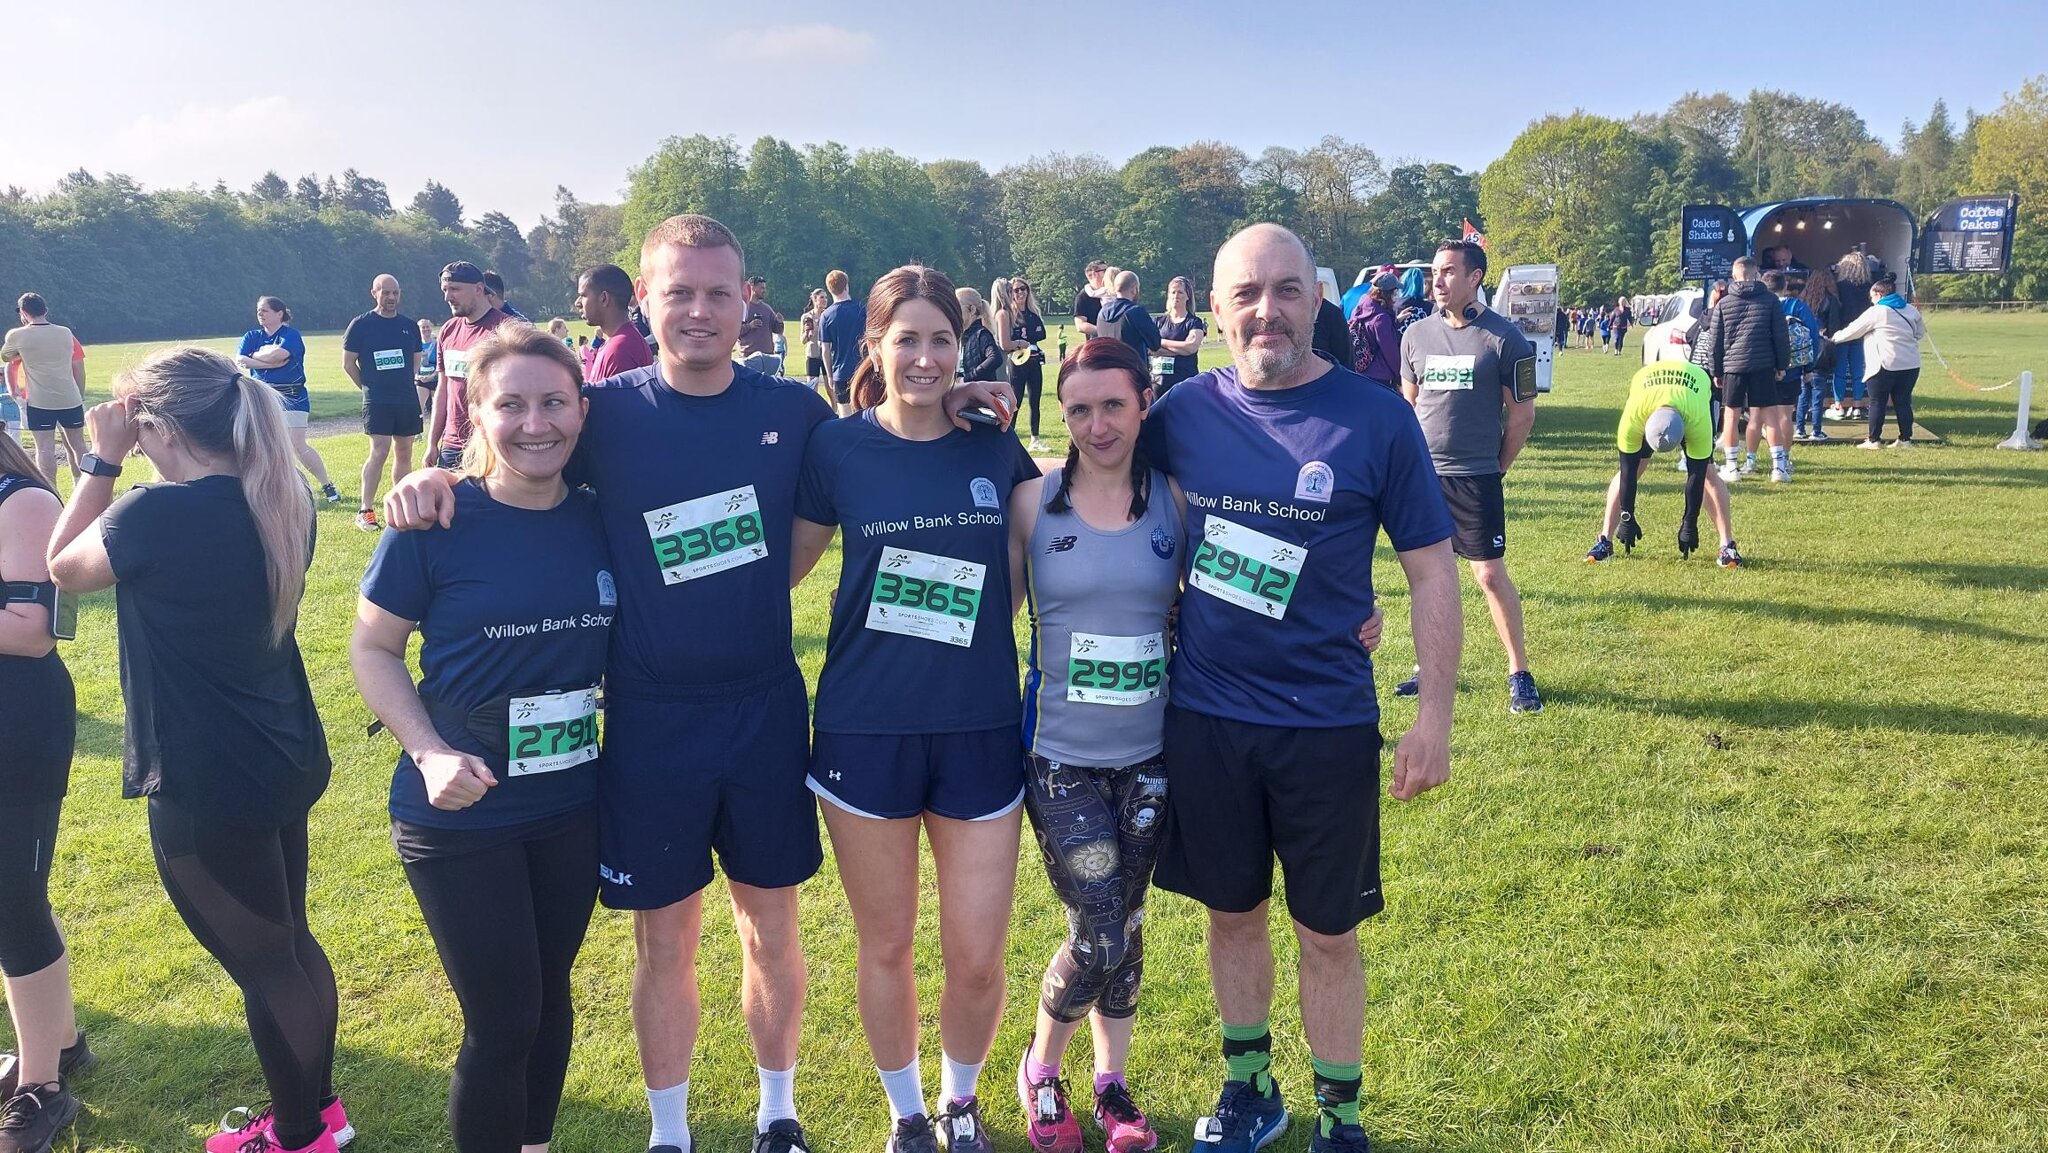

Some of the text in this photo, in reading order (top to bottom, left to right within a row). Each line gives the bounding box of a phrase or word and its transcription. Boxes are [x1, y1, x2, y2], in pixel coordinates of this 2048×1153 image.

[1692, 218, 1721, 228] Cakes
[1960, 206, 2004, 218] Coffee
[1960, 219, 1999, 230] Cakes
[1688, 230, 1723, 240] Shakes
[375, 355, 404, 367] 3000
[1222, 496, 1262, 514] Bank
[1267, 501, 1326, 522] School
[861, 511, 1003, 538] Willow Bank School
[655, 514, 761, 568] 3368
[1194, 540, 1291, 602] 2942
[875, 572, 976, 618] 3365
[483, 613, 614, 639] Willow Bank Scho
[949, 635, 969, 646] 3365
[1071, 659, 1161, 690] 2996
[516, 715, 594, 758] 2791
[599, 862, 633, 886] BLK
